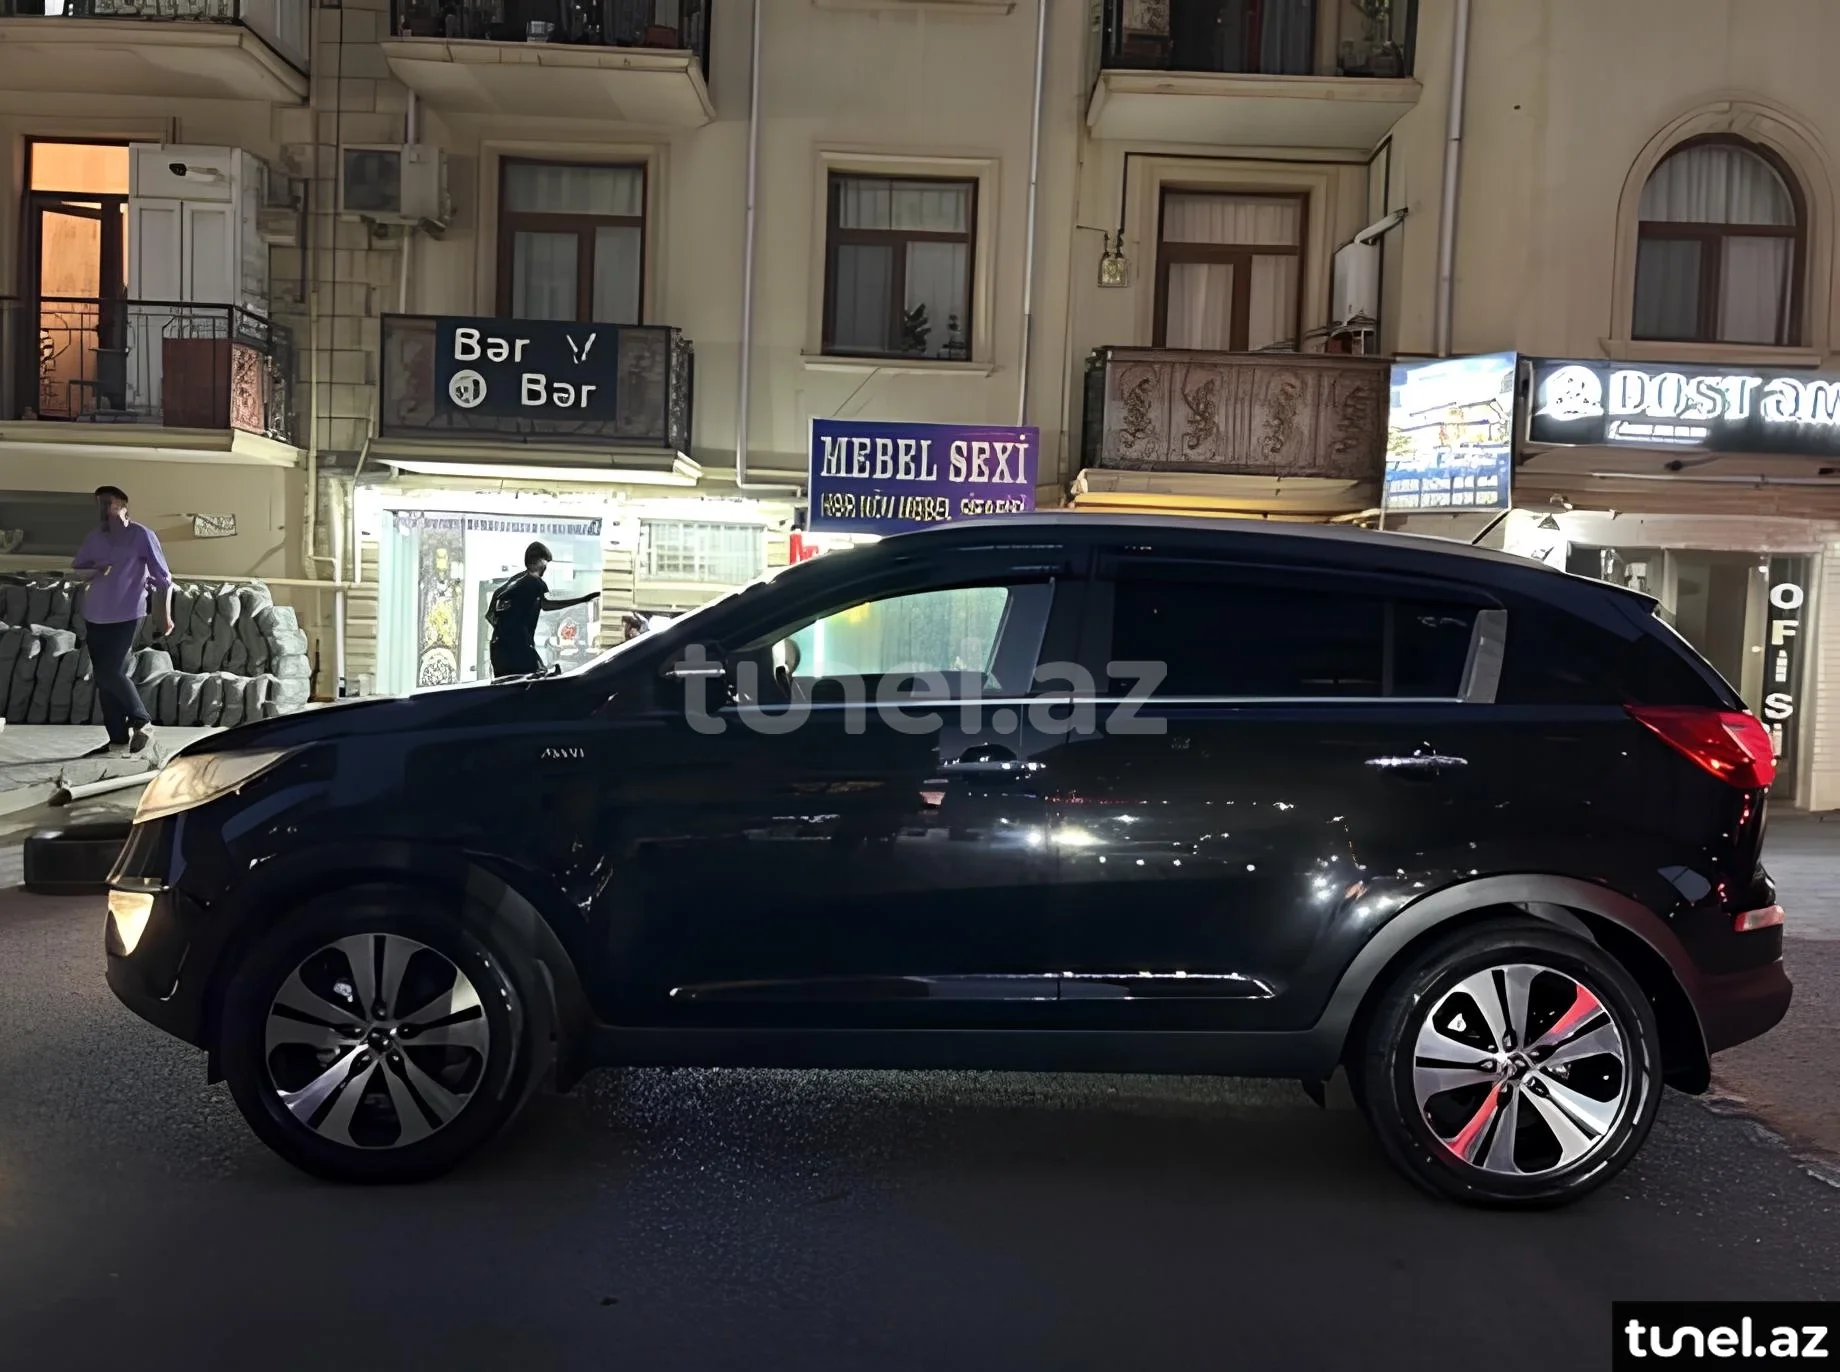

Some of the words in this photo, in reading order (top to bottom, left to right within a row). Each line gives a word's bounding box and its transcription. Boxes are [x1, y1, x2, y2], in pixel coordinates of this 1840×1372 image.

[455, 327, 530, 362] Bər
[521, 373, 597, 408] Bər
[820, 436, 938, 481] MEBEL
[949, 434, 1030, 484] SEXİ
